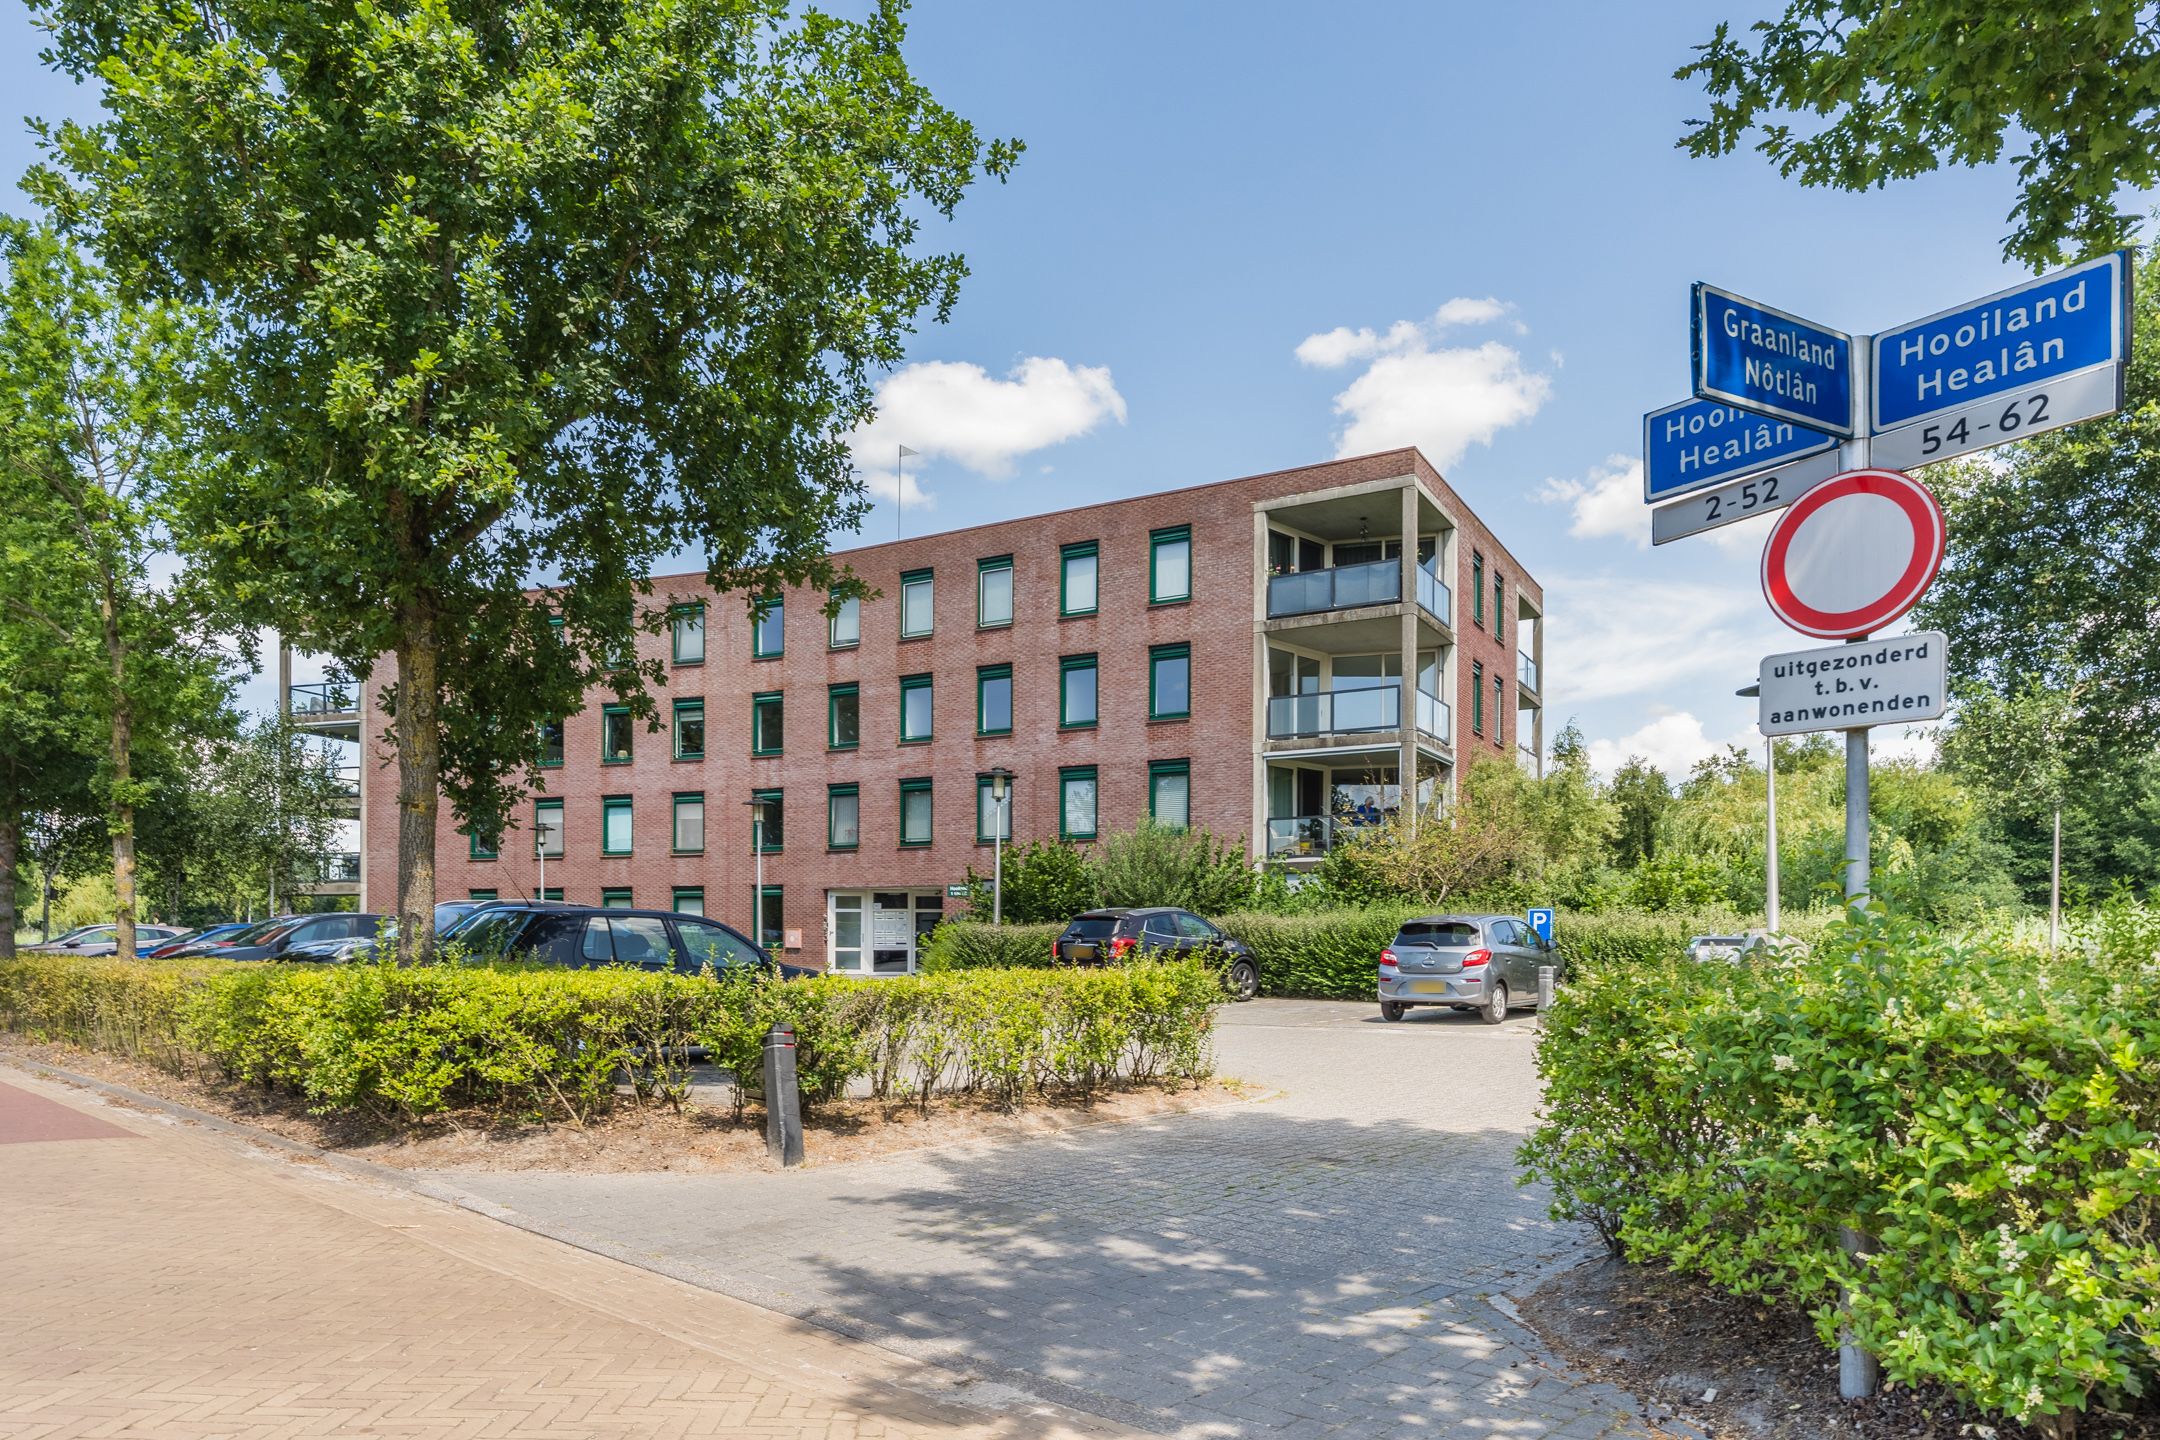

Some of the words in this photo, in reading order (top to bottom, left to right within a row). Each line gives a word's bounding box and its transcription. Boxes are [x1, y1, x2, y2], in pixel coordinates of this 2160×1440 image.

[1723, 308, 1835, 370] Graanland
[1900, 280, 2086, 367] Hooiland
[1745, 356, 1817, 405] Nôtlân
[1917, 337, 2064, 401] Healân
[1680, 423, 1793, 473] Healân
[1922, 394, 2049, 455] 54-62
[1705, 477, 1779, 521] 2-52
[1774, 642, 1929, 679] uitgezonderd
[1770, 694, 1930, 724] aanwonenden
[1533, 912, 1547, 931] P
